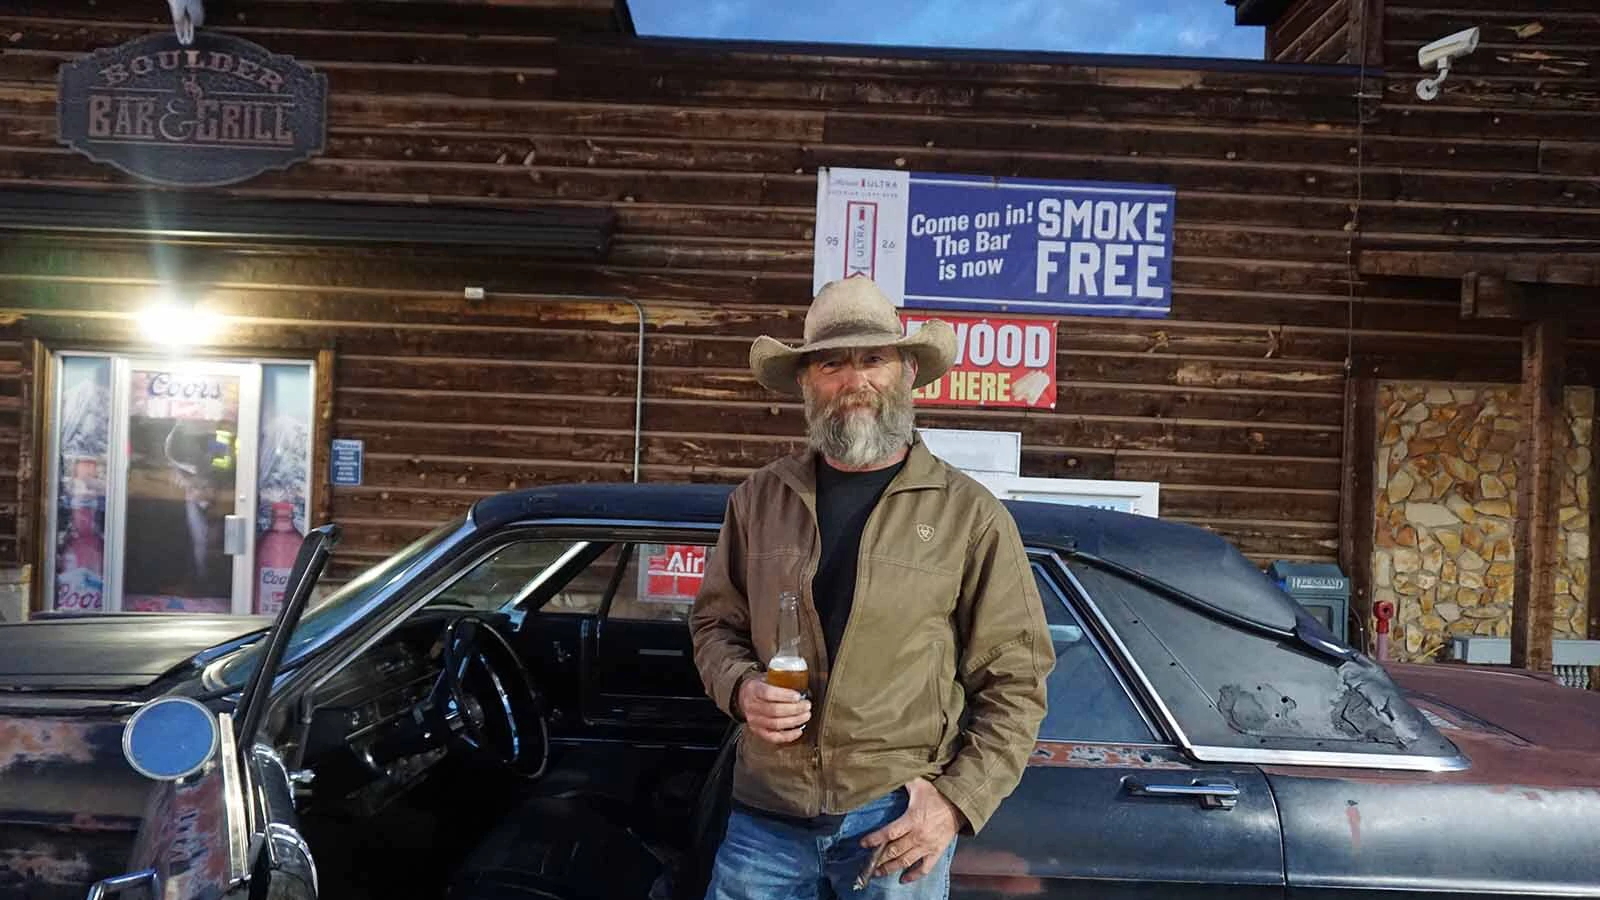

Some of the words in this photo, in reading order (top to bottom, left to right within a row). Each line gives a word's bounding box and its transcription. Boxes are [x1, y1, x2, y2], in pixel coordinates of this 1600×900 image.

[98, 49, 286, 94] BOULDER
[87, 95, 156, 141] BAR
[159, 99, 199, 142] &
[195, 98, 295, 145] GRILL
[911, 213, 970, 237] Come
[974, 211, 1000, 229] on
[1005, 201, 1033, 226] in!
[1037, 198, 1168, 242] SMOKE
[825, 235, 839, 246] 95
[933, 234, 970, 257] The
[975, 231, 1011, 253] Bar
[938, 259, 957, 281] is
[962, 257, 1004, 278] now
[1036, 240, 1165, 299] FREE
[147, 372, 223, 399] Coors
[950, 371, 1011, 402] HERE
